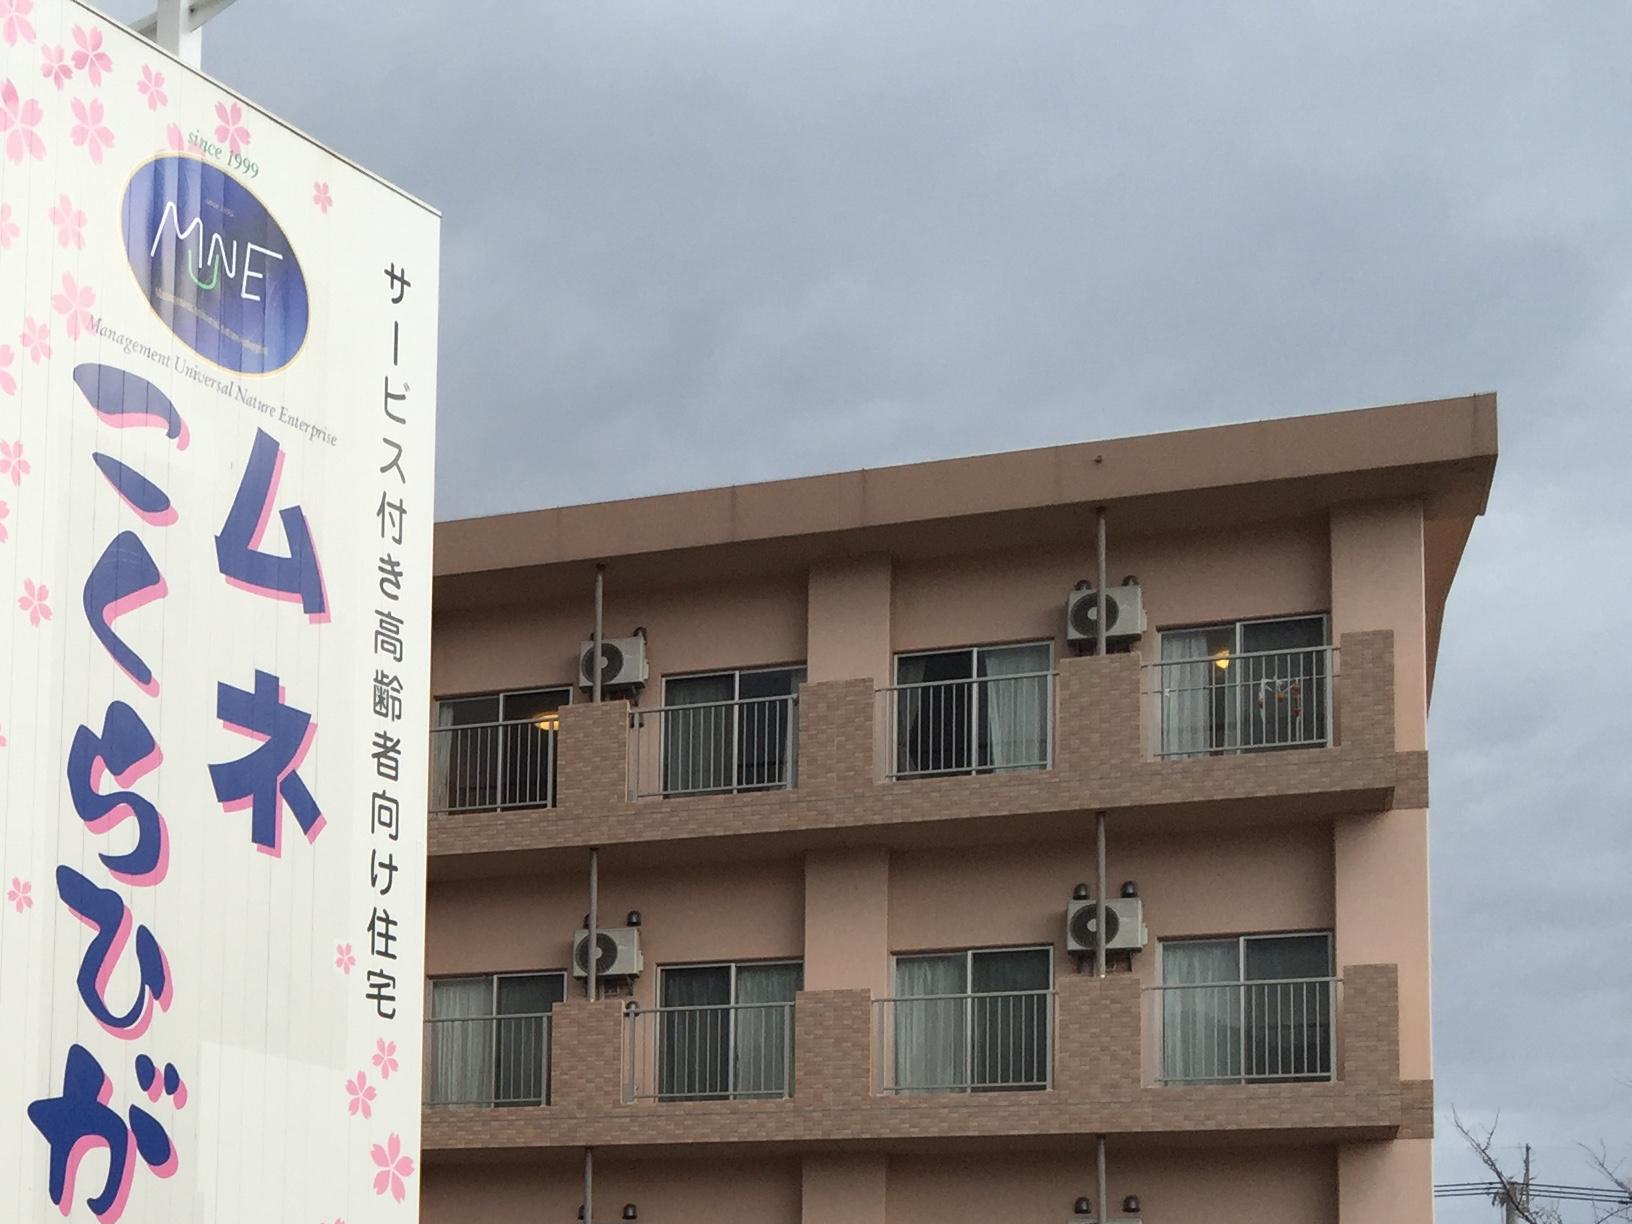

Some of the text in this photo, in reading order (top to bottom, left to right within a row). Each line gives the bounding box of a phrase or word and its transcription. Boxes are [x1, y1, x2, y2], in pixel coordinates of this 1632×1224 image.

[187, 129, 260, 179] since 1999
[88, 313, 172, 368] Management
[174, 355, 234, 398] Universal
[236, 386, 276, 419] Nature
[278, 406, 338, 447] Enterprise
[207, 427, 331, 858] ムネ
[365, 262, 412, 1020] サービス付き高齢者向け住宅
